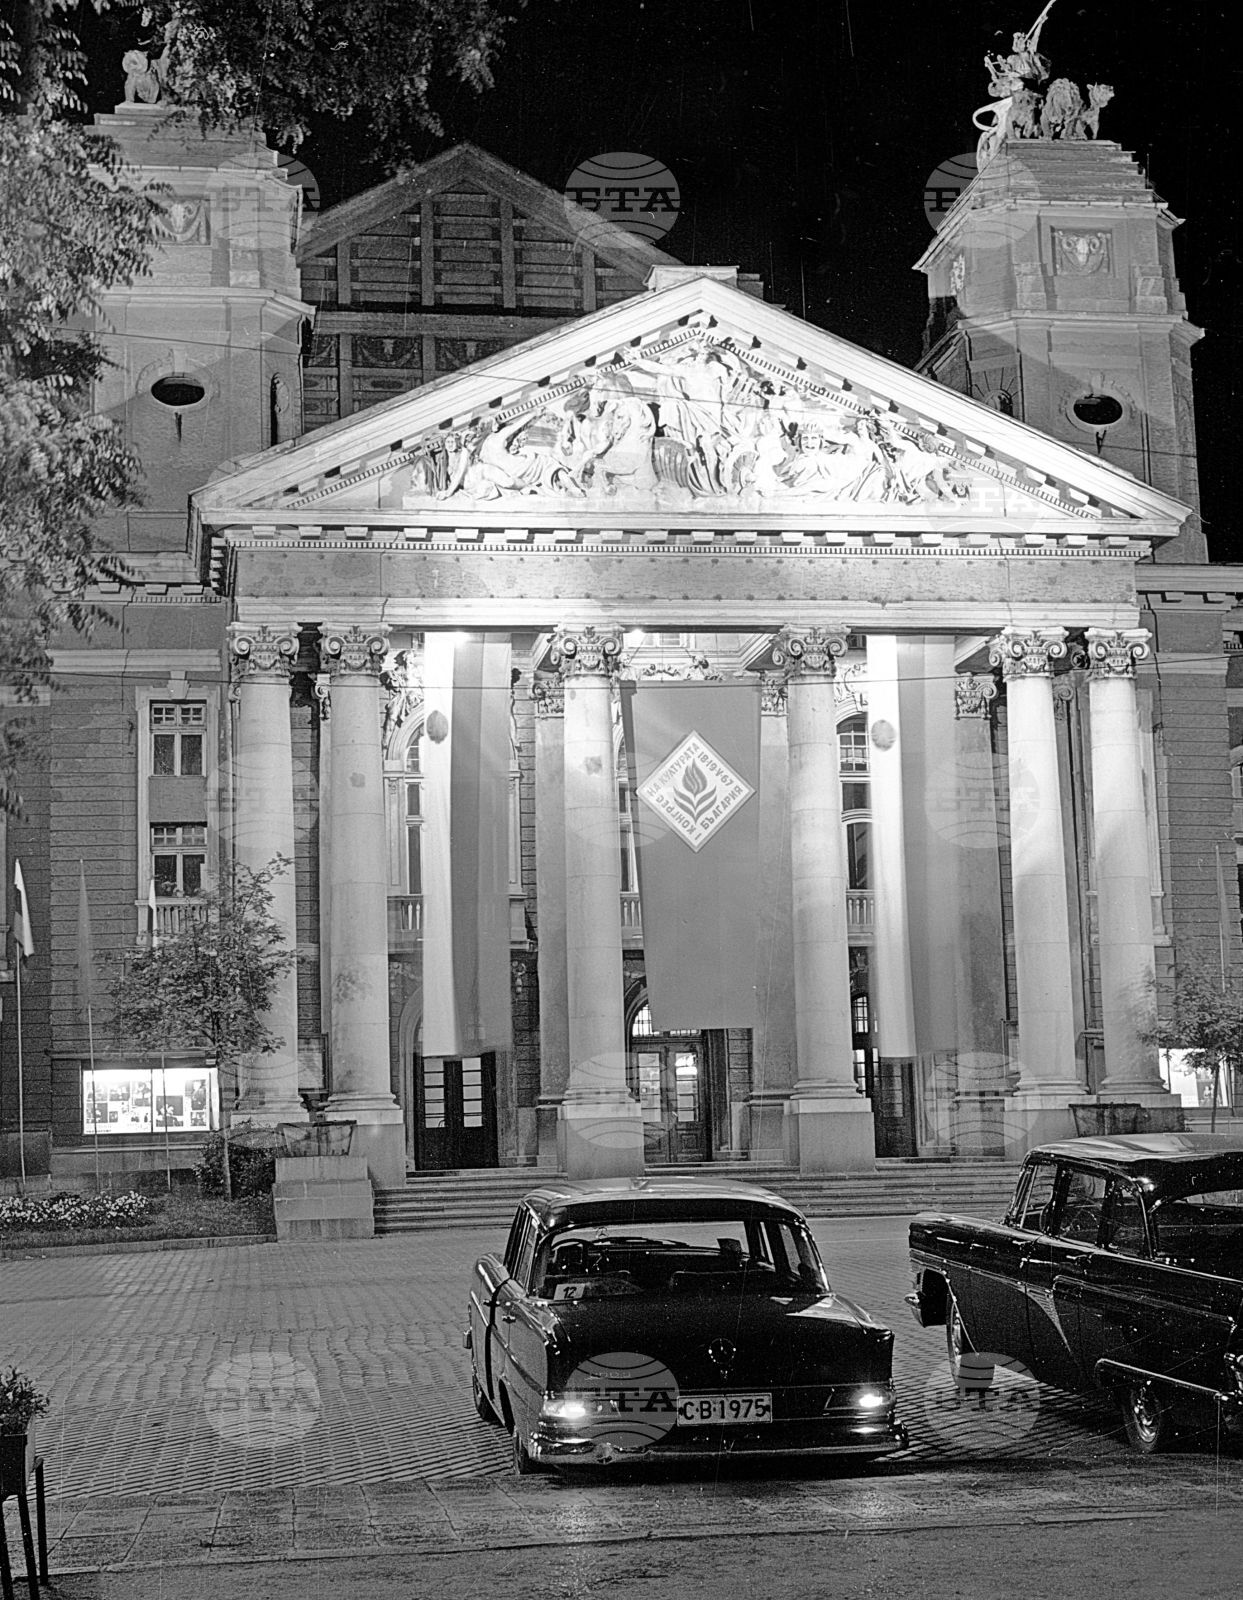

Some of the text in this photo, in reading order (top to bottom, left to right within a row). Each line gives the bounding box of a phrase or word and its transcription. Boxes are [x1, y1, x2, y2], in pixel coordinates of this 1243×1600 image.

[646, 742, 700, 797] НА КУЛТУРАТА
[655, 795, 697, 835] КОНГРЕС
[700, 785, 744, 830] БЪЛГАРИЯ
[563, 1286, 577, 1299] 12
